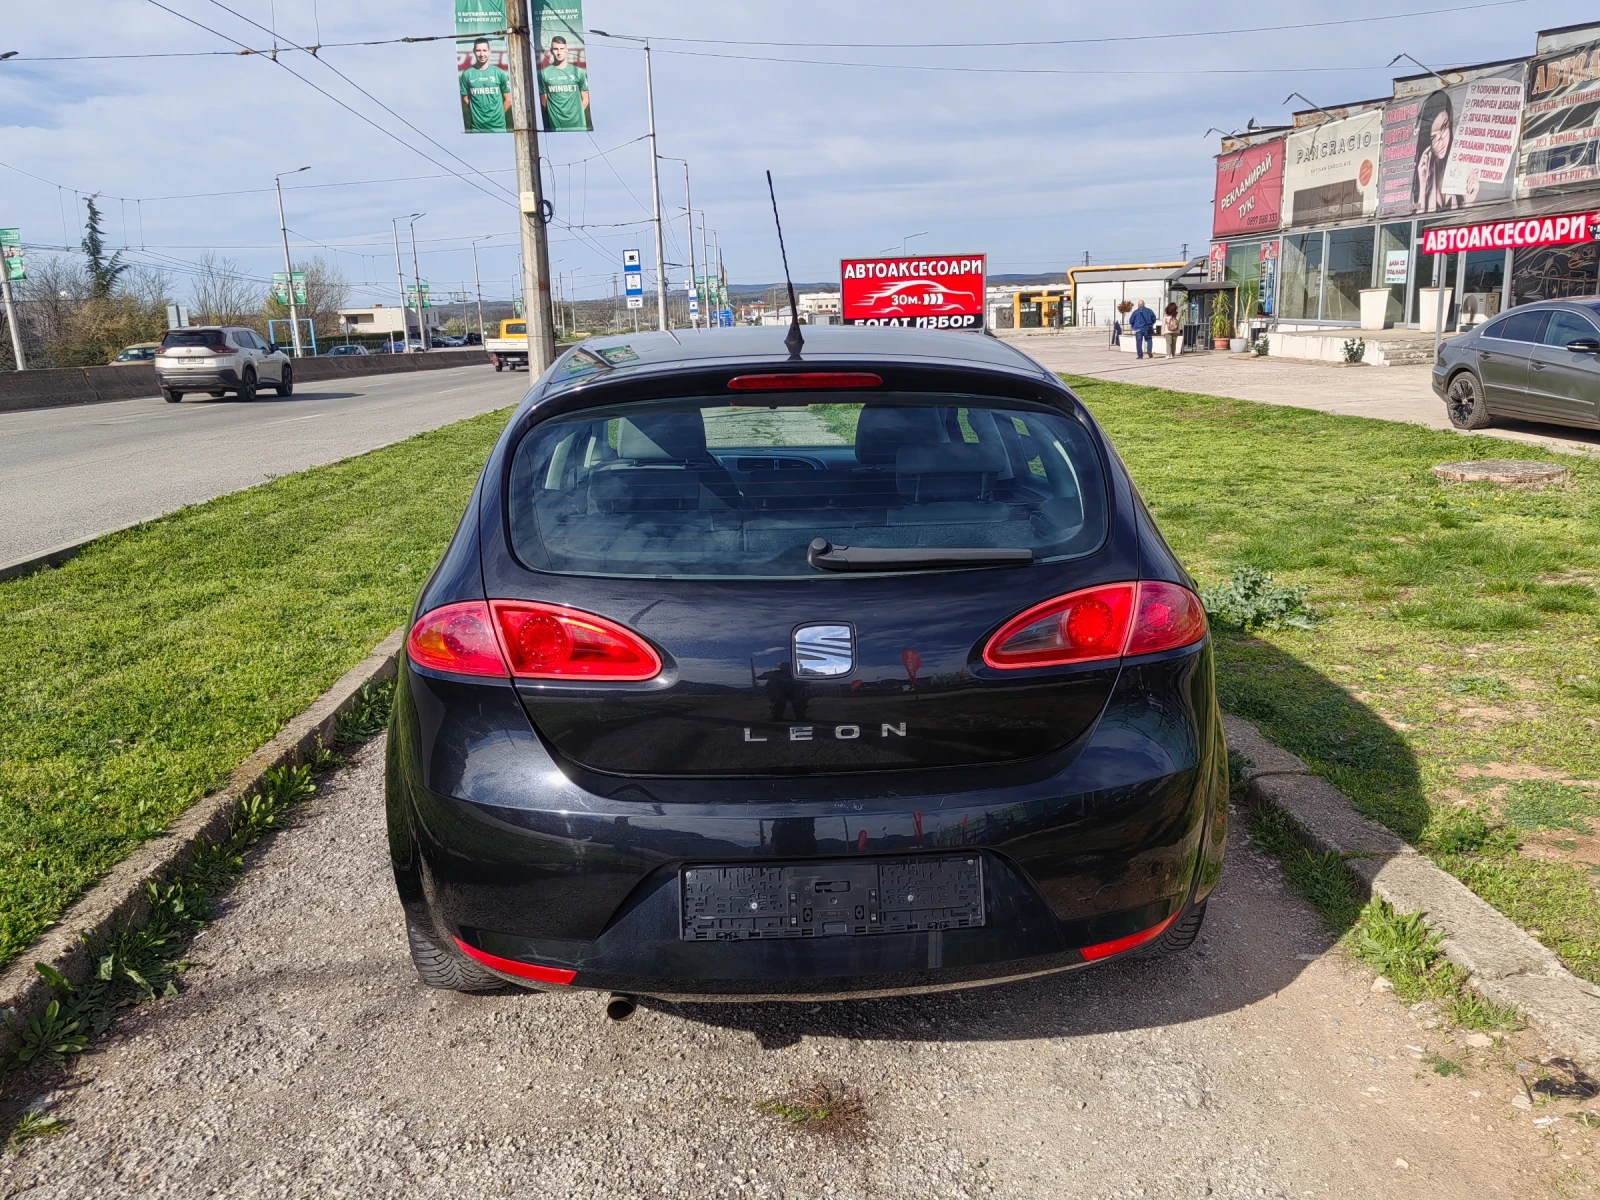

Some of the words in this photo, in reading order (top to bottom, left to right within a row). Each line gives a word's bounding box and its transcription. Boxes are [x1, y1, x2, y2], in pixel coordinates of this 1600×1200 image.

[470, 86, 499, 95] WINBET
[548, 85, 578, 93] WINBET
[1476, 85, 1500, 95] КОПИРНИ
[1500, 85, 1521, 95] УСЛУГИ
[1470, 98, 1498, 110] ГРАФИЧЕН
[1497, 100, 1521, 110] ДИЗАЙН
[1468, 113, 1491, 124] ПЕЧАТНА
[1491, 114, 1517, 125] РЕКЛАМА
[1385, 124, 1413, 146] ЦЕНТЪР
[1464, 126, 1486, 137] ВЪНШНА
[1486, 128, 1512, 140] РЕКЛАМА
[1296, 132, 1372, 165] PANCRACIO
[1458, 139, 1485, 151] РЕКЛАМНИ
[1484, 141, 1513, 154] СУВЕНИРИ
[1310, 164, 1327, 174] ARTISAN
[1327, 160, 1352, 171] CHOCOLATE
[1457, 152, 1484, 164] ФИРМЕНИ
[1483, 156, 1505, 168] ПЕЧАТИ
[1221, 151, 1272, 212] РЕКЛАМИРАЙ
[1238, 195, 1255, 219] ТУК!
[1425, 215, 1586, 252] АВТОАКСЕСОАРИ
[844, 259, 982, 279] АВТОАКСЕСОАРИ
[916, 315, 975, 329] ИЗБОР
[743, 722, 907, 742] LEON
